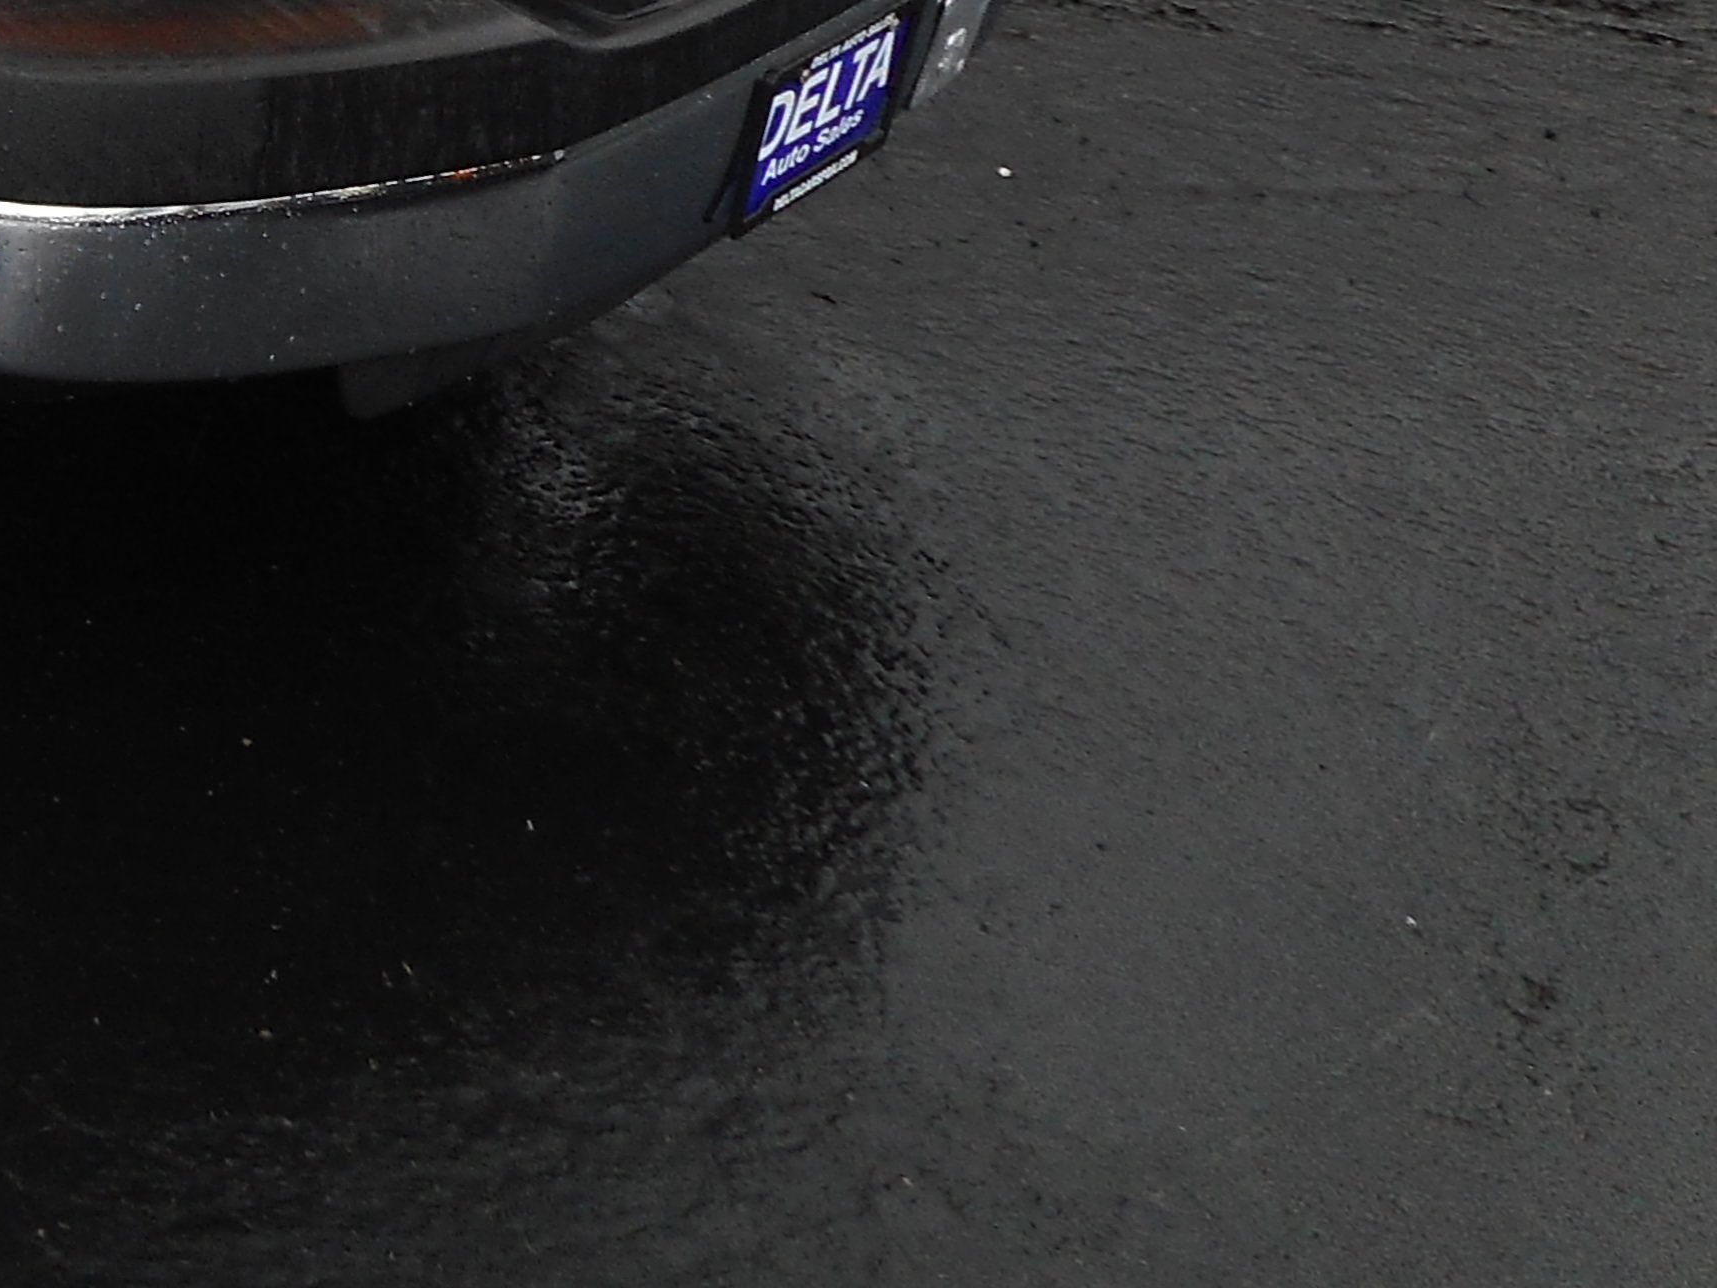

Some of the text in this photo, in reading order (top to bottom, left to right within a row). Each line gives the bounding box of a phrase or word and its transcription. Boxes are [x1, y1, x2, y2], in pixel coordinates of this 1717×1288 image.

[757, 30, 896, 162] DELTA
[760, 108, 865, 187] Auto Sales
